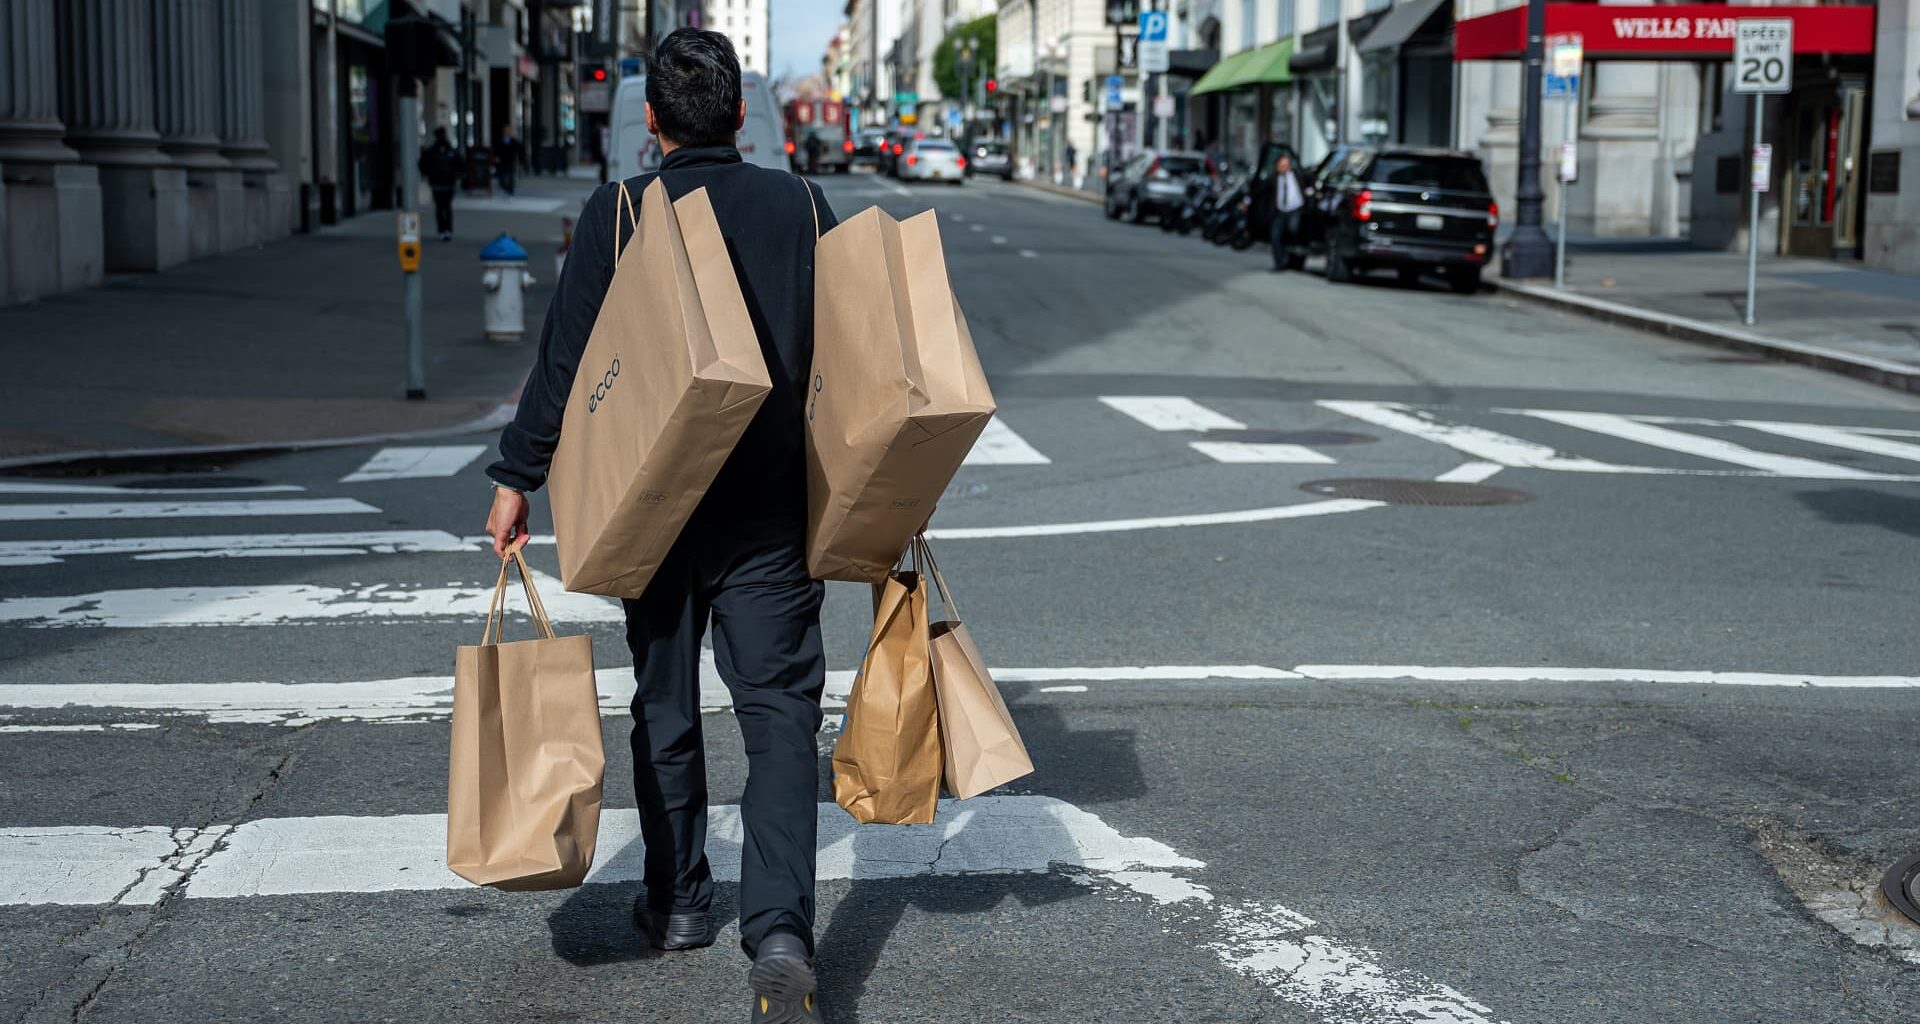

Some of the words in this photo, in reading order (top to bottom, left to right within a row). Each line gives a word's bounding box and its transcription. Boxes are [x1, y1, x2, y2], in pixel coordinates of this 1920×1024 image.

[1613, 18, 1690, 38] WELLS
[1695, 18, 1737, 38] FAR
[1741, 26, 1787, 40] SPEED
[1745, 43, 1782, 52] LIMIT
[1742, 58, 1784, 83] 20
[589, 358, 620, 413] ecco
